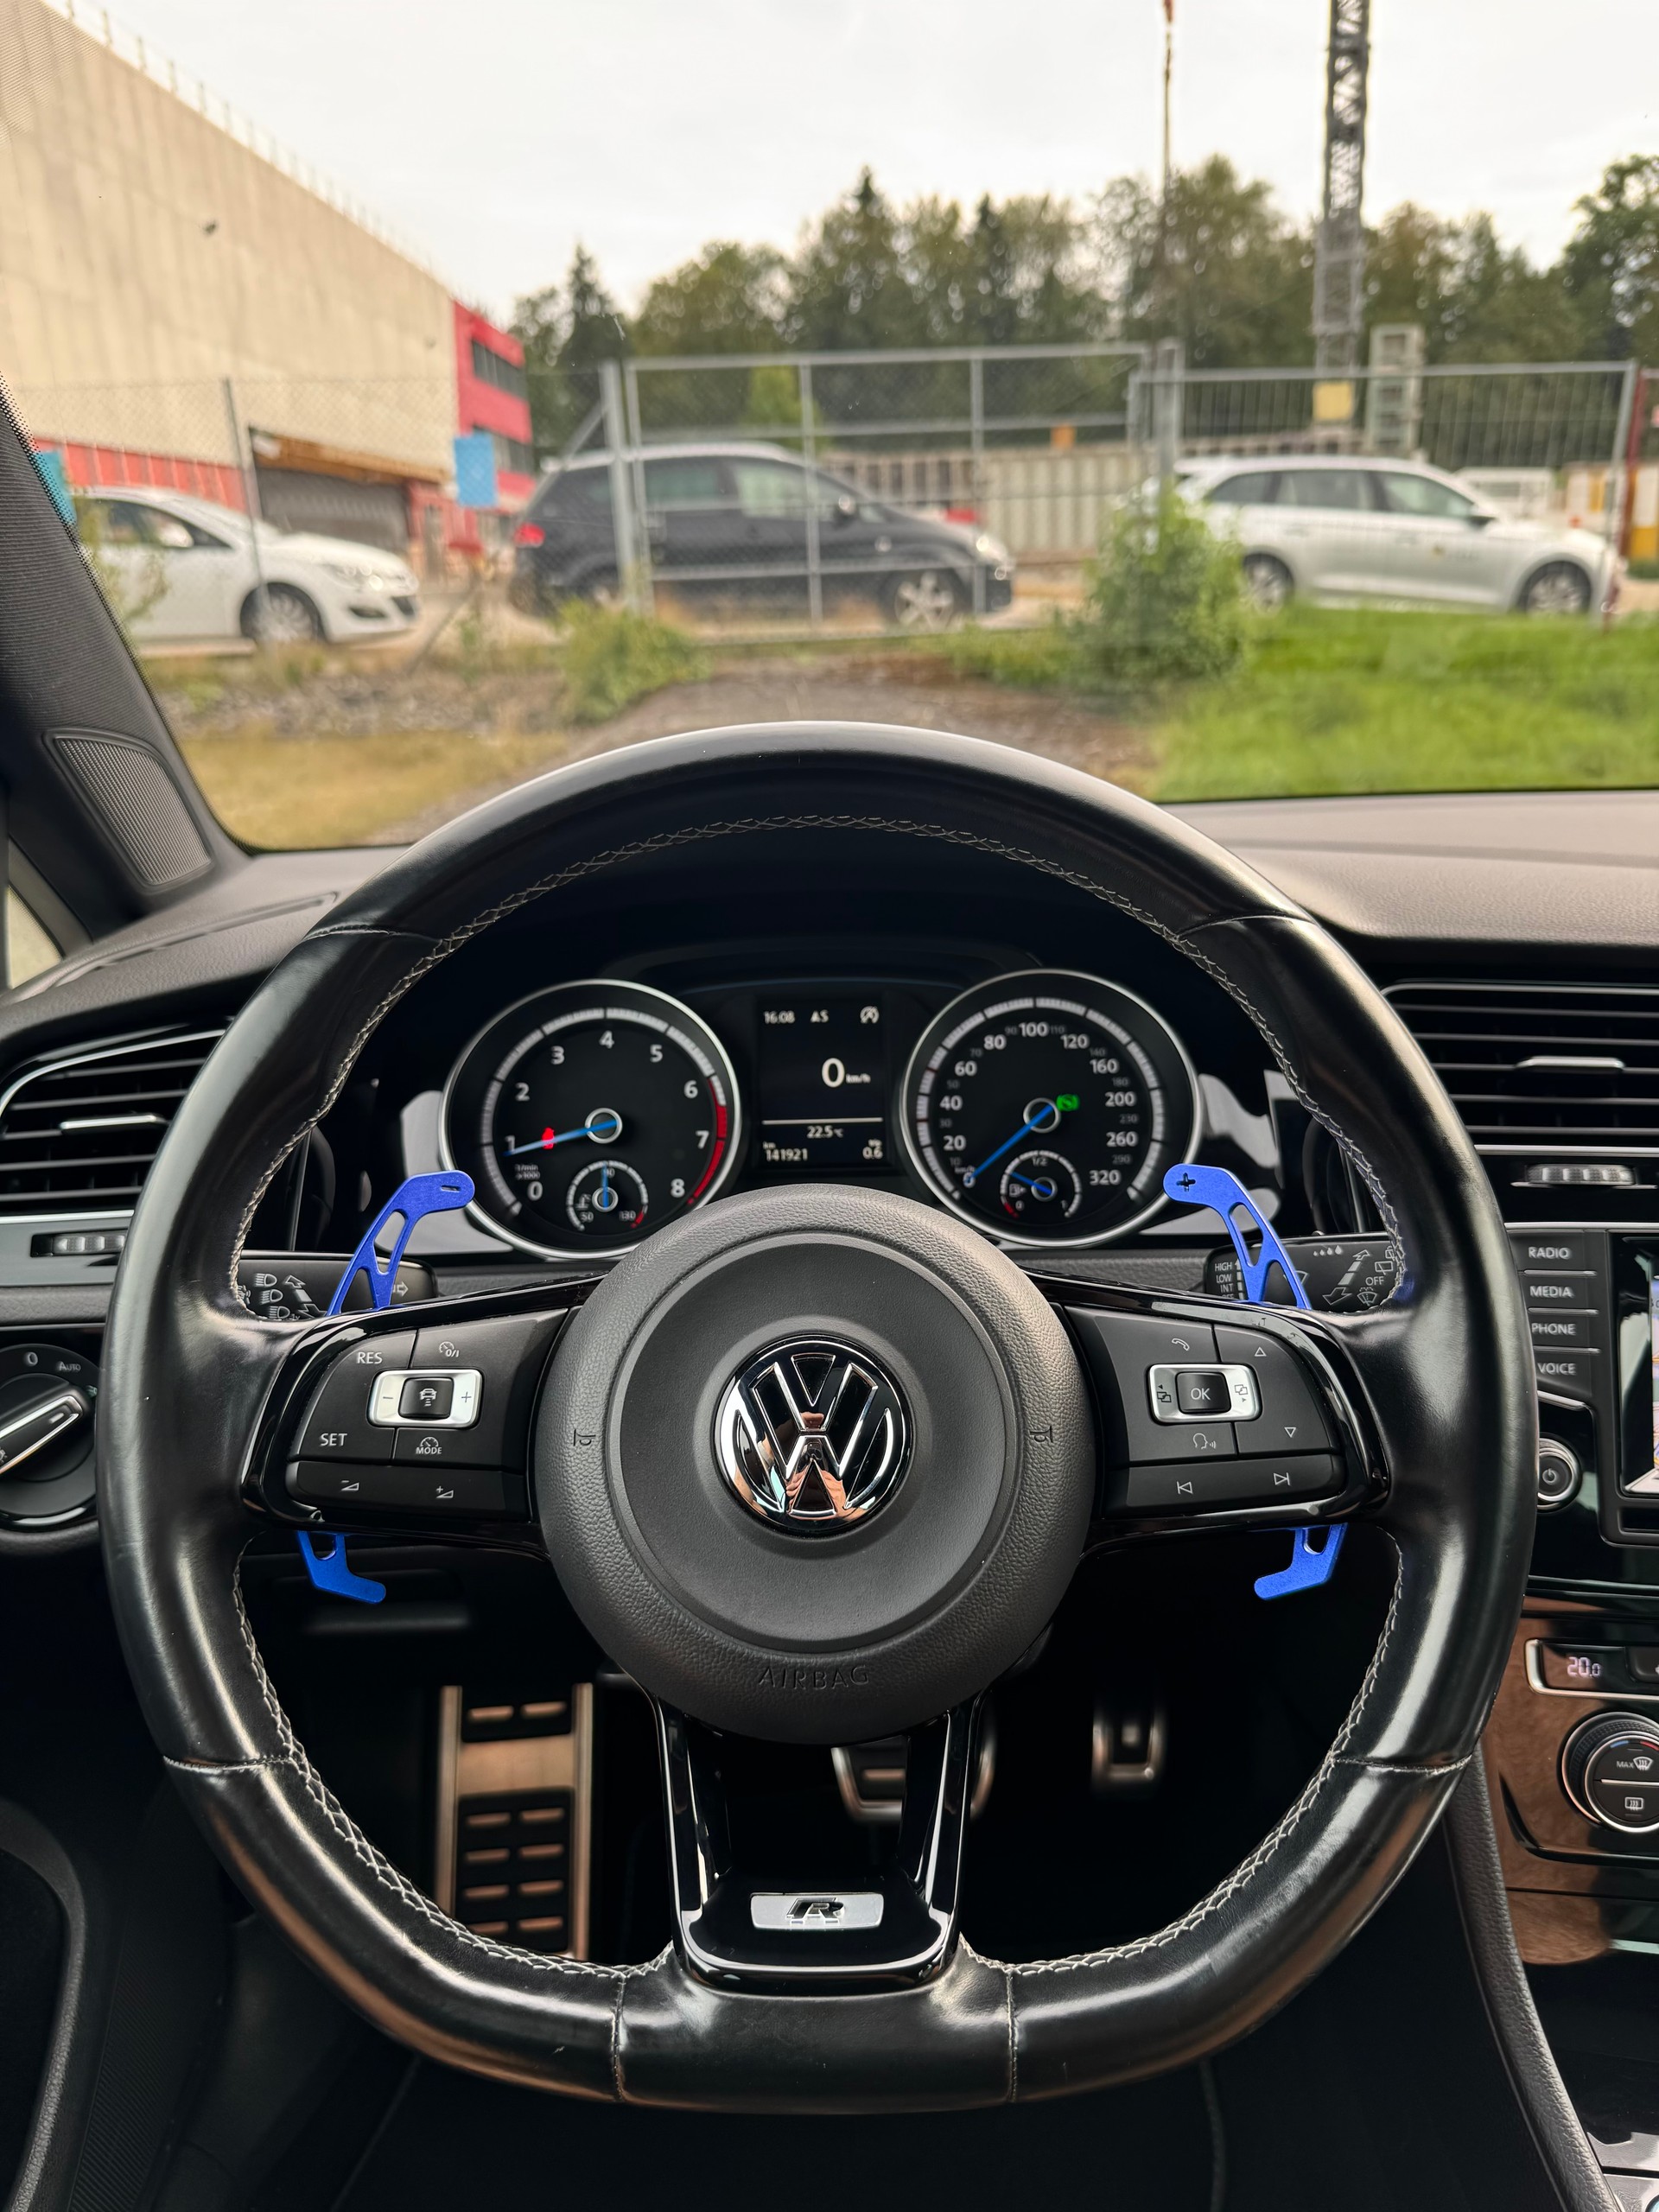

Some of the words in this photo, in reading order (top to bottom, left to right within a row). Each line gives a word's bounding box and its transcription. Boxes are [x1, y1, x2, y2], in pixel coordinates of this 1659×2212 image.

[1019, 1022, 1048, 1037] 100
[599, 1031, 614, 1049] 4
[983, 1035, 1007, 1049] 80
[1060, 1034, 1089, 1049] 120
[551, 1046, 565, 1065] 3
[651, 1045, 663, 1063] 5
[822, 1058, 845, 1088] 0
[955, 1061, 977, 1076] 60
[1090, 1059, 1119, 1074] 160
[516, 1083, 530, 1101] 2
[684, 1080, 698, 1098] 6
[939, 1096, 963, 1110] 40
[1105, 1092, 1136, 1107] 200
[505, 1136, 516, 1154] 1
[696, 1130, 709, 1148] 7
[944, 1135, 966, 1150] 20
[1106, 1132, 1138, 1147] 260
[963, 1172, 976, 1188] 0
[1090, 1170, 1121, 1185] 320
[527, 1181, 543, 1201] 0
[671, 1179, 685, 1198] 8
[1528, 1247, 1571, 1259] RADIO
[1214, 1262, 1232, 1272] HIGH
[1216, 1274, 1232, 1283] LOW
[1365, 1276, 1384, 1286] OFF
[1220, 1283, 1233, 1293] INT
[1529, 1286, 1573, 1298] MEDIA
[1531, 1323, 1576, 1335] PHONE
[357, 1351, 383, 1364] RES
[1538, 1363, 1576, 1375] VOICE
[1191, 1388, 1211, 1402] OK
[319, 1433, 347, 1447] SET
[416, 1446, 442, 1455] MODE
[1567, 1656, 1602, 1678] 20.0
[759, 1665, 869, 1690] AIRBAG
[1617, 1760, 1635, 1769] MAX
[785, 1897, 845, 1925] R
